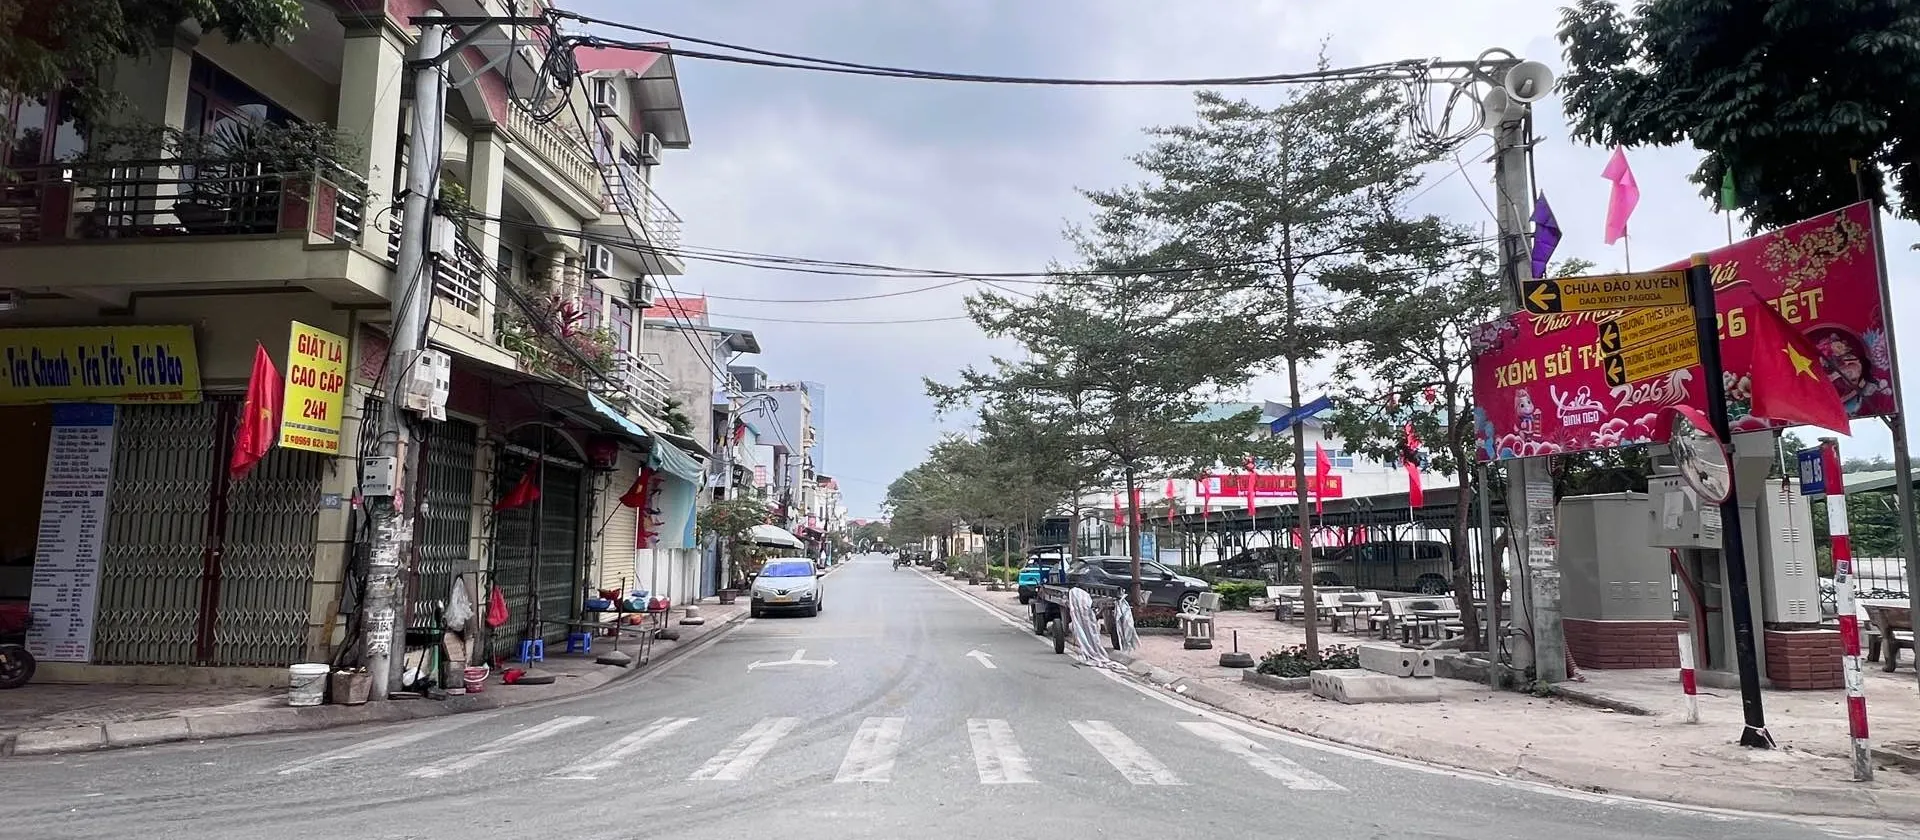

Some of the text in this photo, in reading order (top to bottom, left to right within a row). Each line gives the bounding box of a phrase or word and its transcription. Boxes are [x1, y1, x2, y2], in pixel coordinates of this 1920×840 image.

[1563, 276, 1680, 296] CHÙA ĐÀO XUYÊN
[1579, 293, 1662, 305] DAO XUYEN PAGODA
[1645, 308, 1664, 322] THCS
[297, 333, 326, 361] GIẶT
[291, 364, 344, 394] CAO CẤP
[1495, 357, 1538, 389] XÓM
[1609, 379, 1663, 414] 2026
[302, 398, 327, 421] 24H
